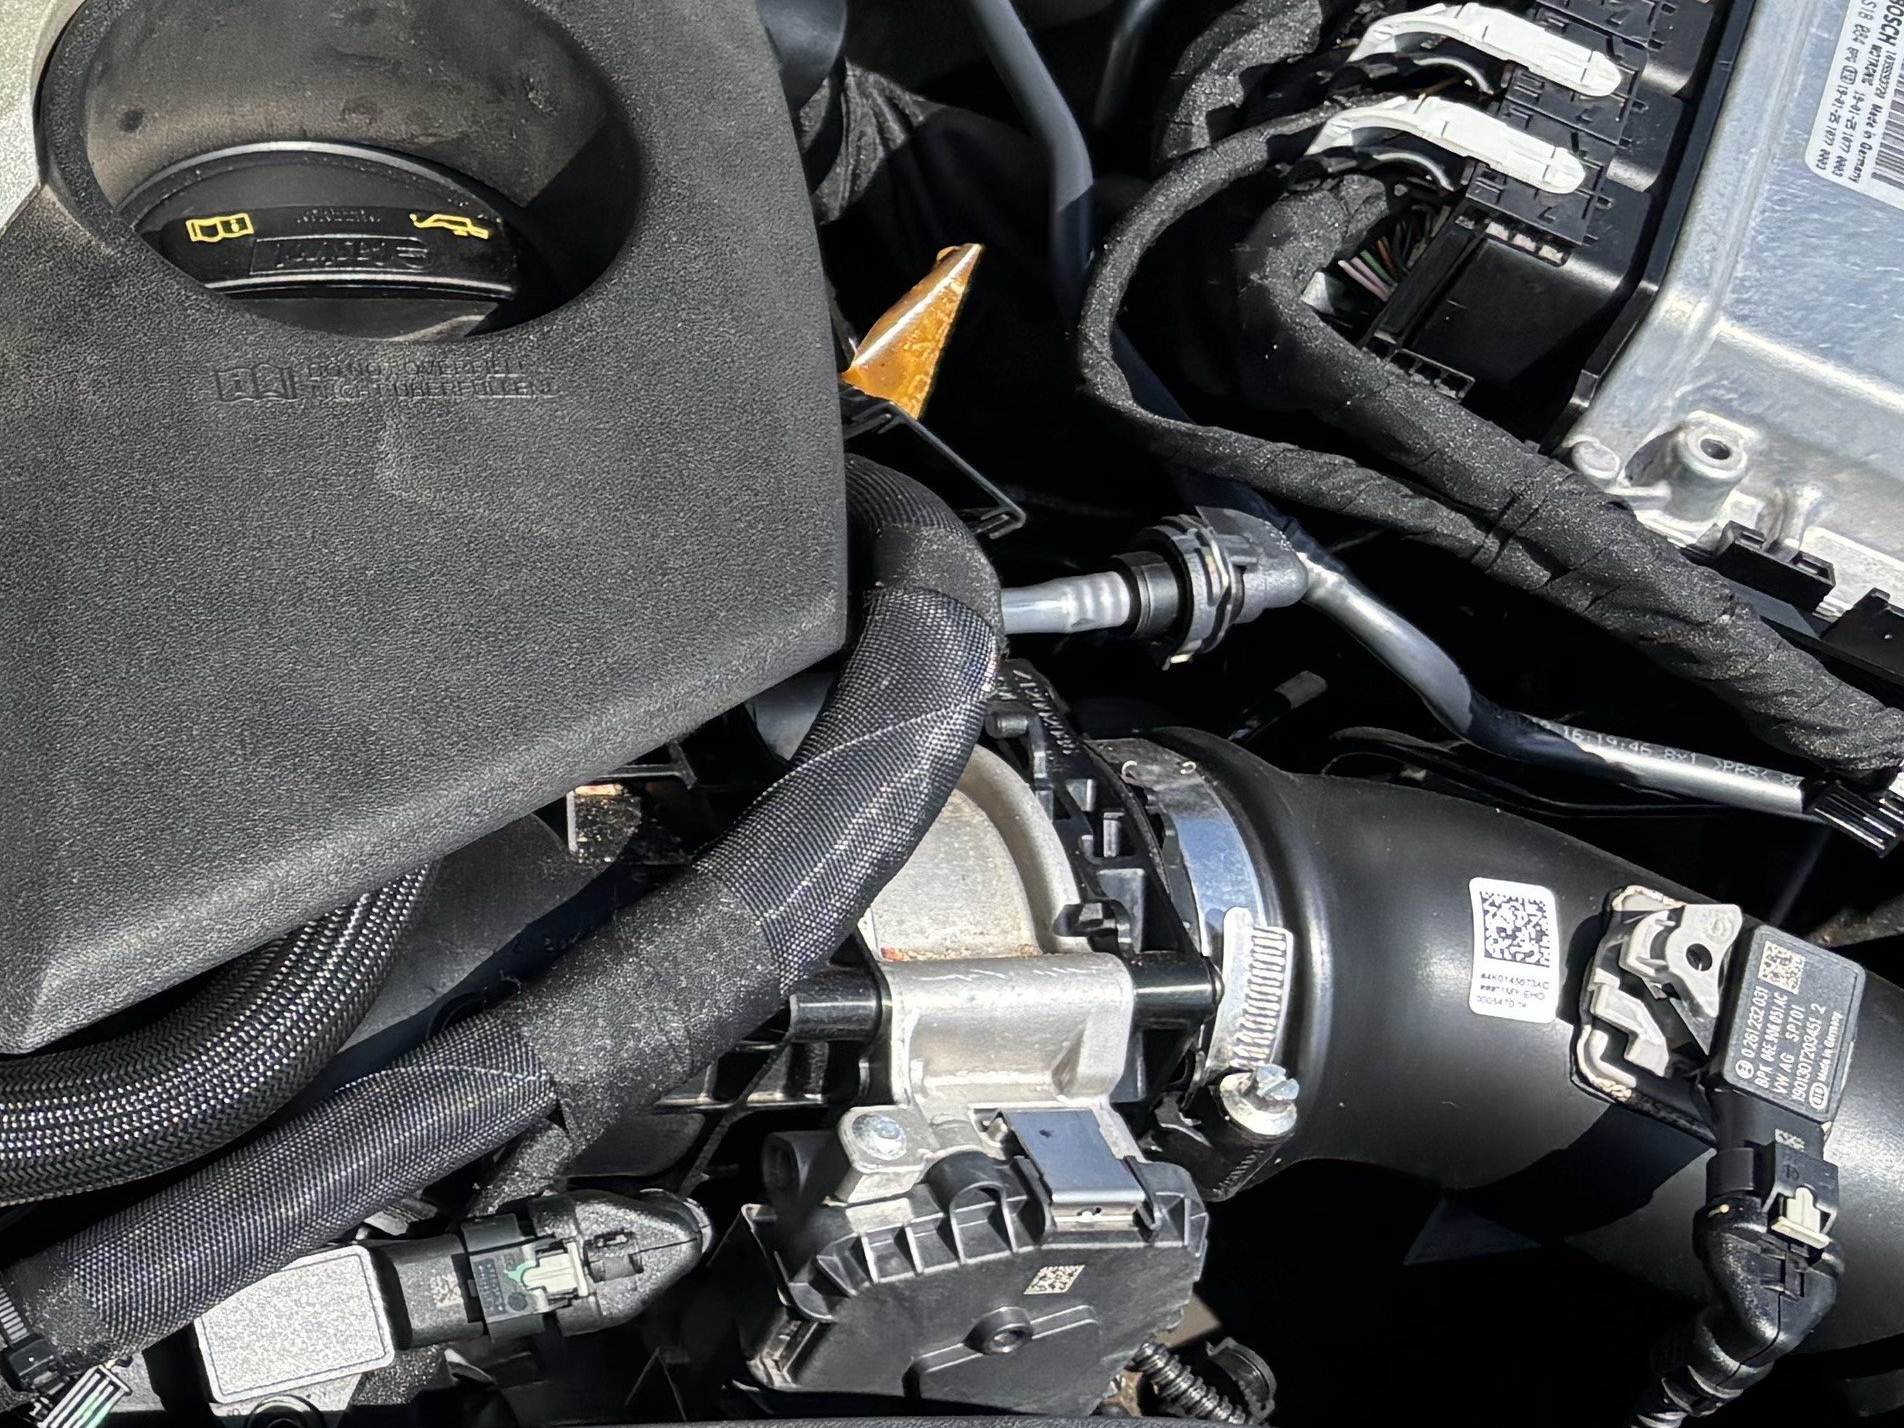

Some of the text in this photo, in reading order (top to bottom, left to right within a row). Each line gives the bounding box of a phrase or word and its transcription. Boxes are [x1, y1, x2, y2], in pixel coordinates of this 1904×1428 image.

[1810, 1002, 1827, 1015] 2
[1741, 985, 1770, 1059] 0 261 232 031
[1779, 1052, 1795, 1073] AG
[1772, 1073, 1791, 1095] VW
